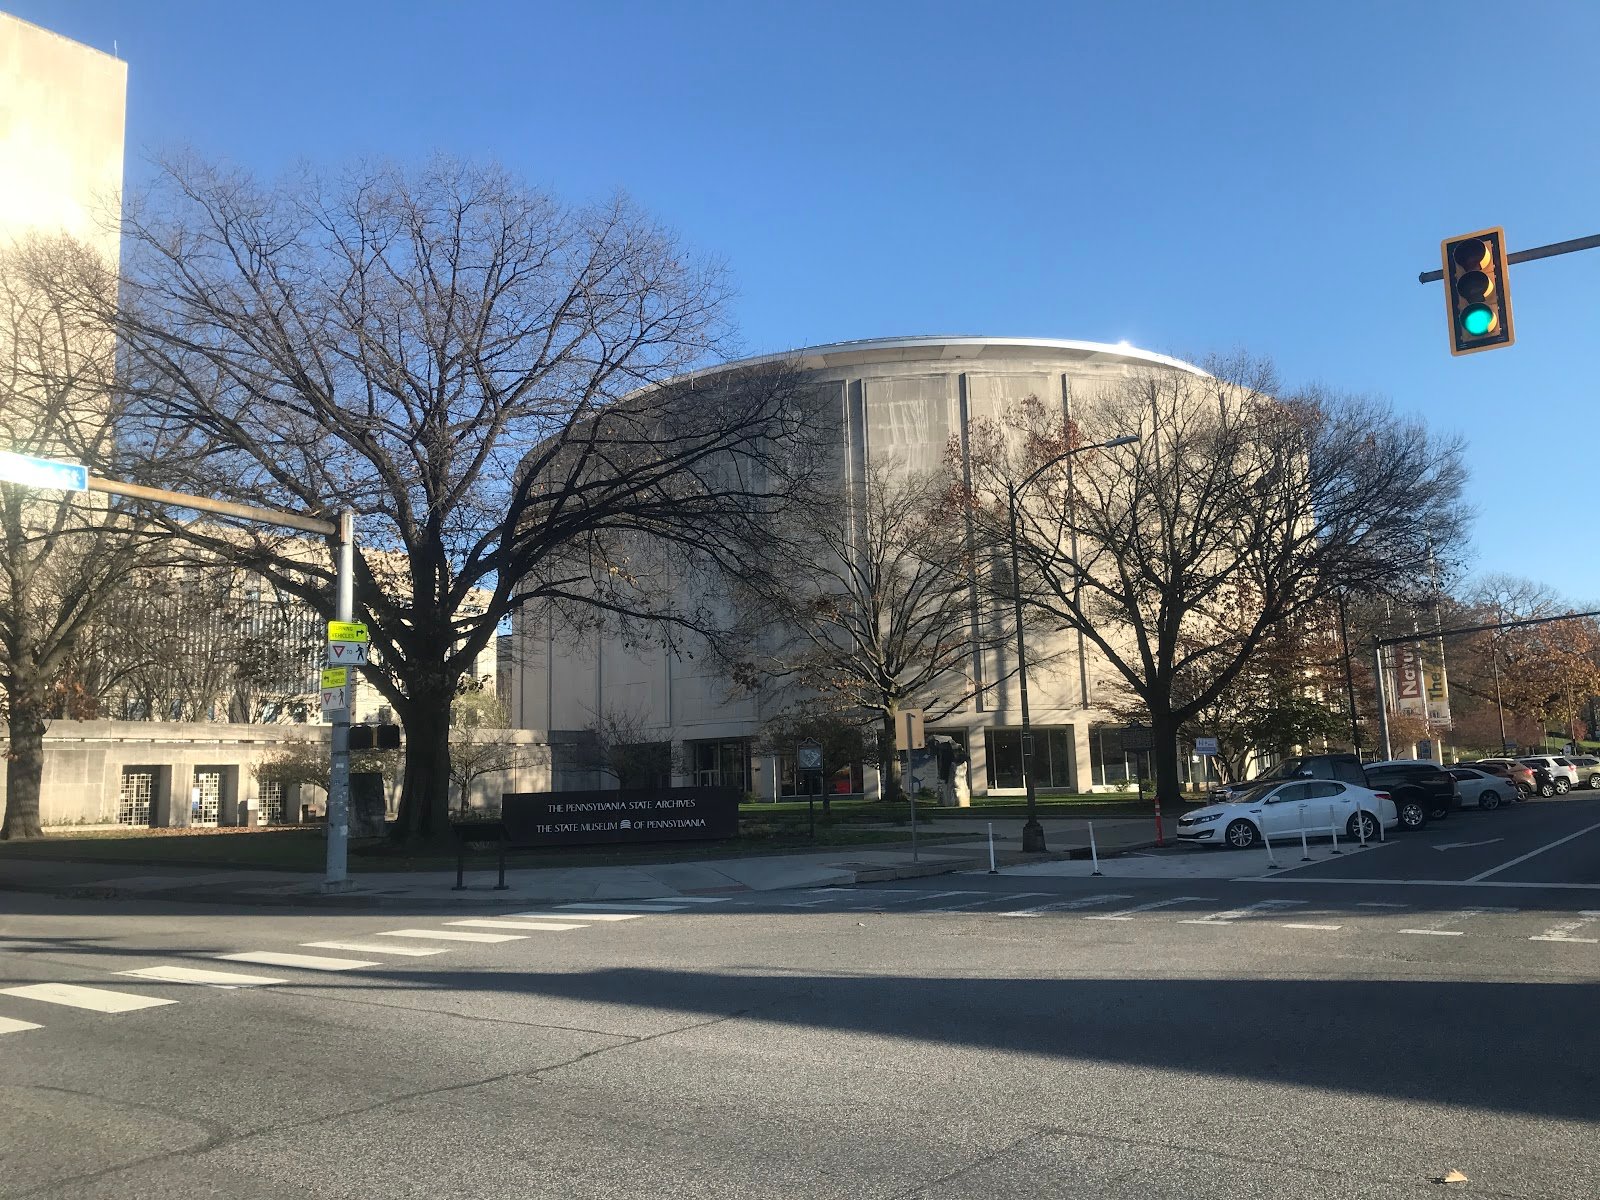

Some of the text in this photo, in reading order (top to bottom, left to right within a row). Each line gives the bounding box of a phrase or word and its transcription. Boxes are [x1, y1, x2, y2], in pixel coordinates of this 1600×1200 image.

[1427, 671, 1444, 701] The
[548, 799, 696, 813] THE PENNSYLVANIA STATE ARCHIVES
[536, 819, 706, 833] THE STATE MUSEUM OF PENNSYLVANIA
